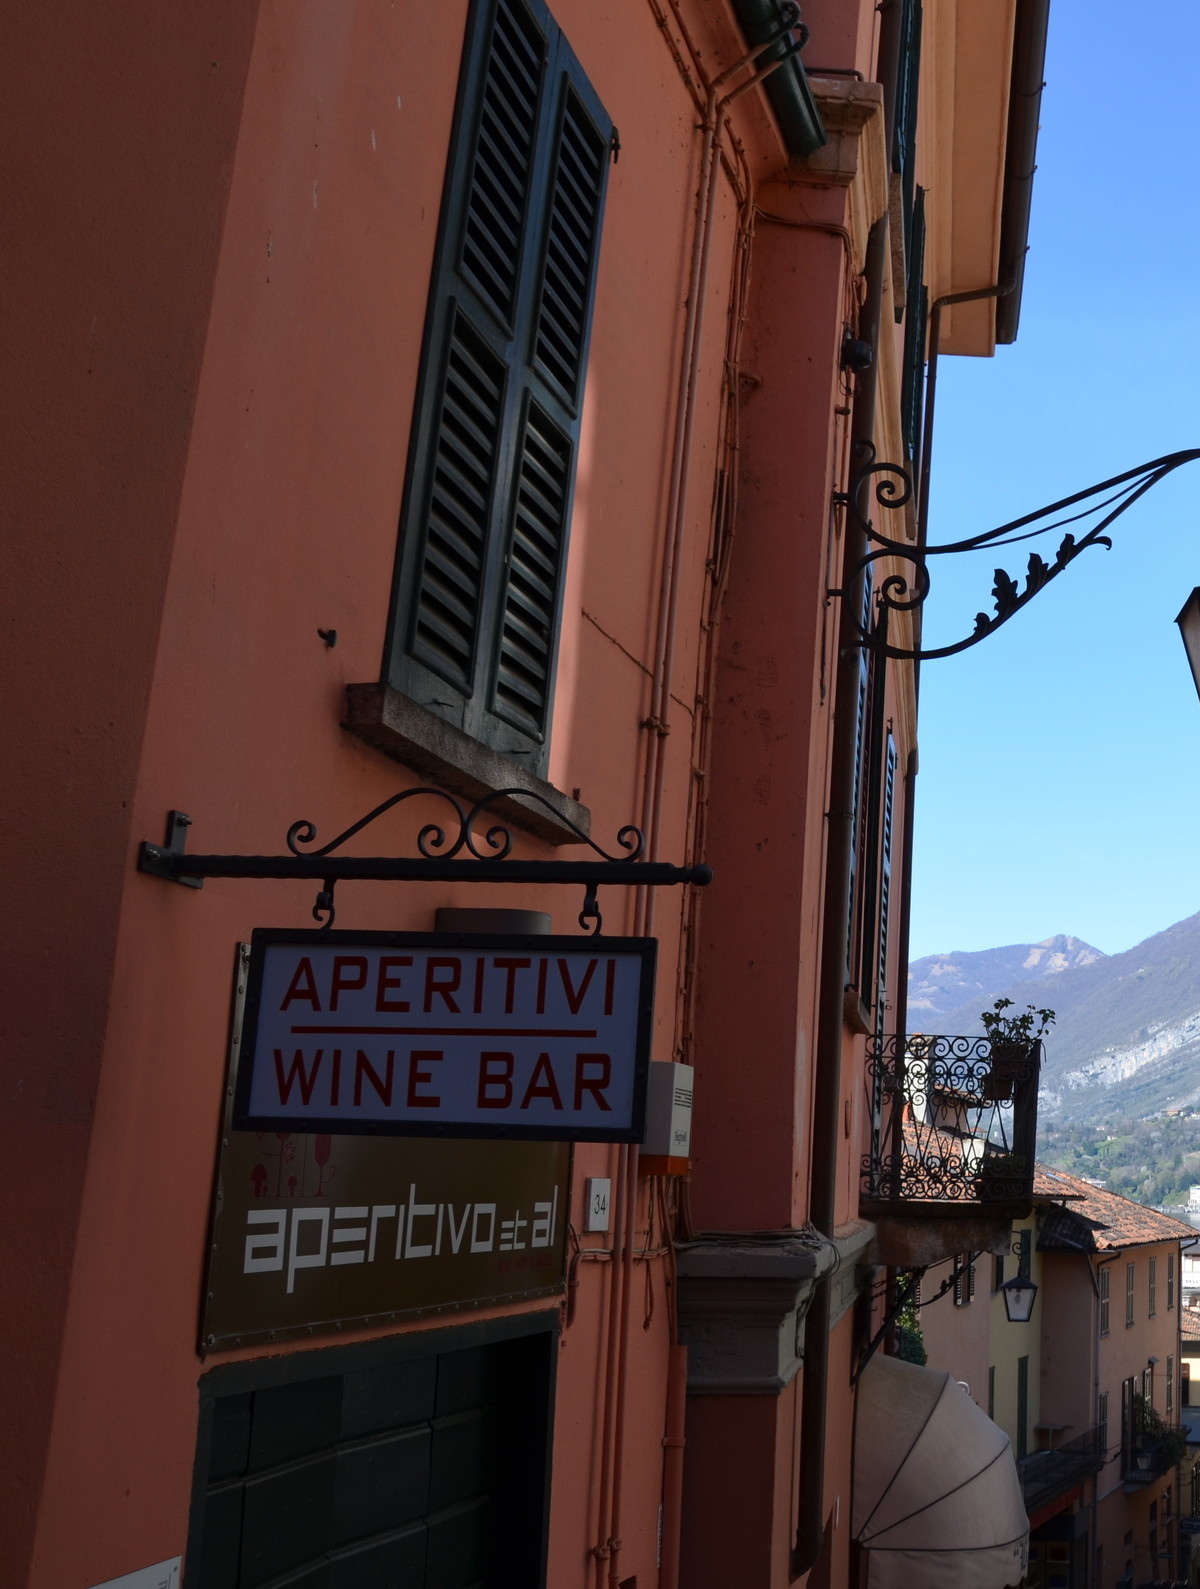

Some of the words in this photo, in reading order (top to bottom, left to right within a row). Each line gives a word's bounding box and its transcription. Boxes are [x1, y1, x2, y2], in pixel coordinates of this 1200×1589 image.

[279, 955, 617, 1016] APERITIVI
[273, 1048, 444, 1108] WINE
[476, 1051, 612, 1112] BAR
[594, 1193, 606, 1215] 34
